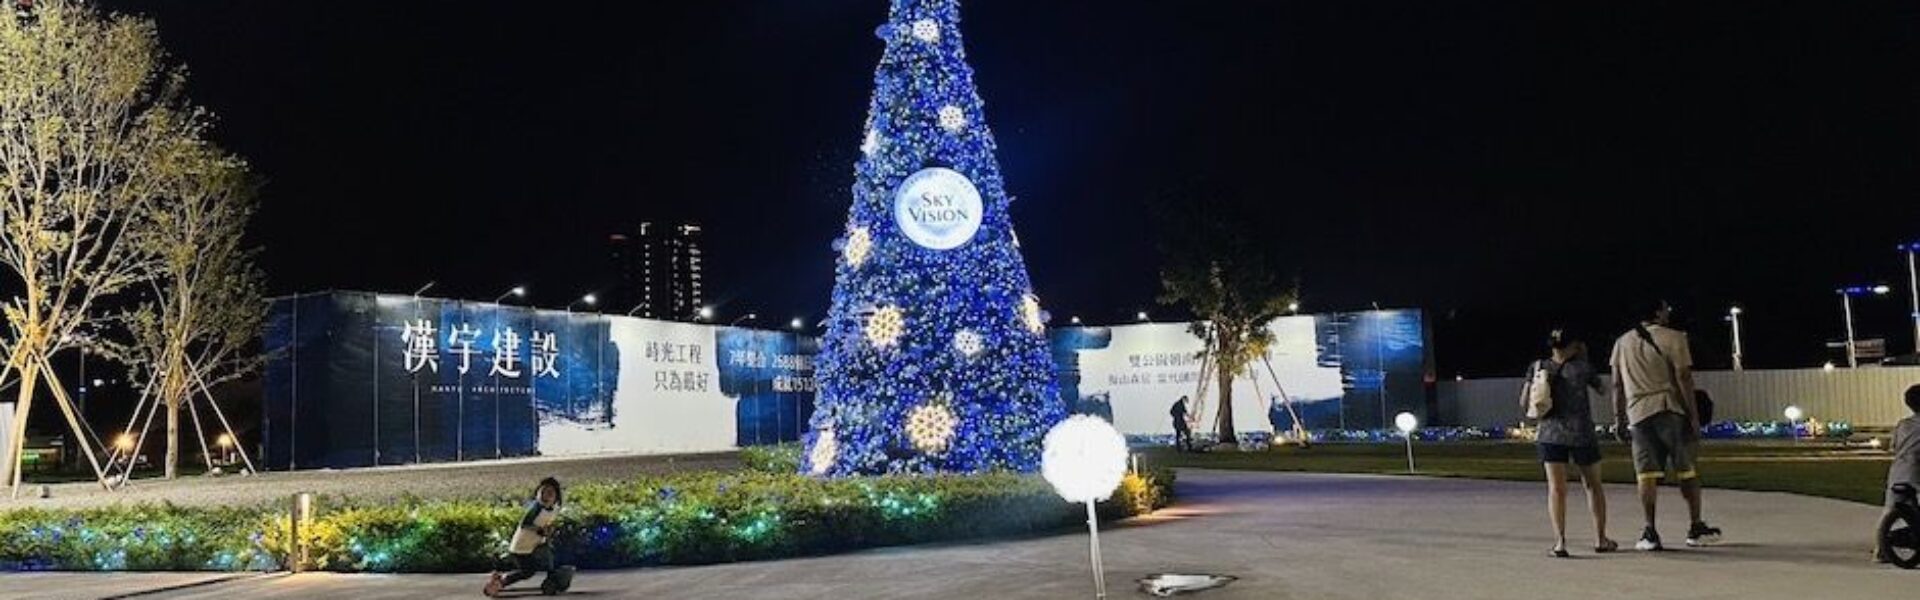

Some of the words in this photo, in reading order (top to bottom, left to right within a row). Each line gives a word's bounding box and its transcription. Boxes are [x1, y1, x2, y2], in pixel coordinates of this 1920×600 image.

[921, 192, 953, 207] SKY
[908, 207, 968, 222] VISION
[401, 318, 560, 378] 漢宇建設
[645, 341, 701, 364] 時光工程
[654, 370, 710, 393] 只為最好
